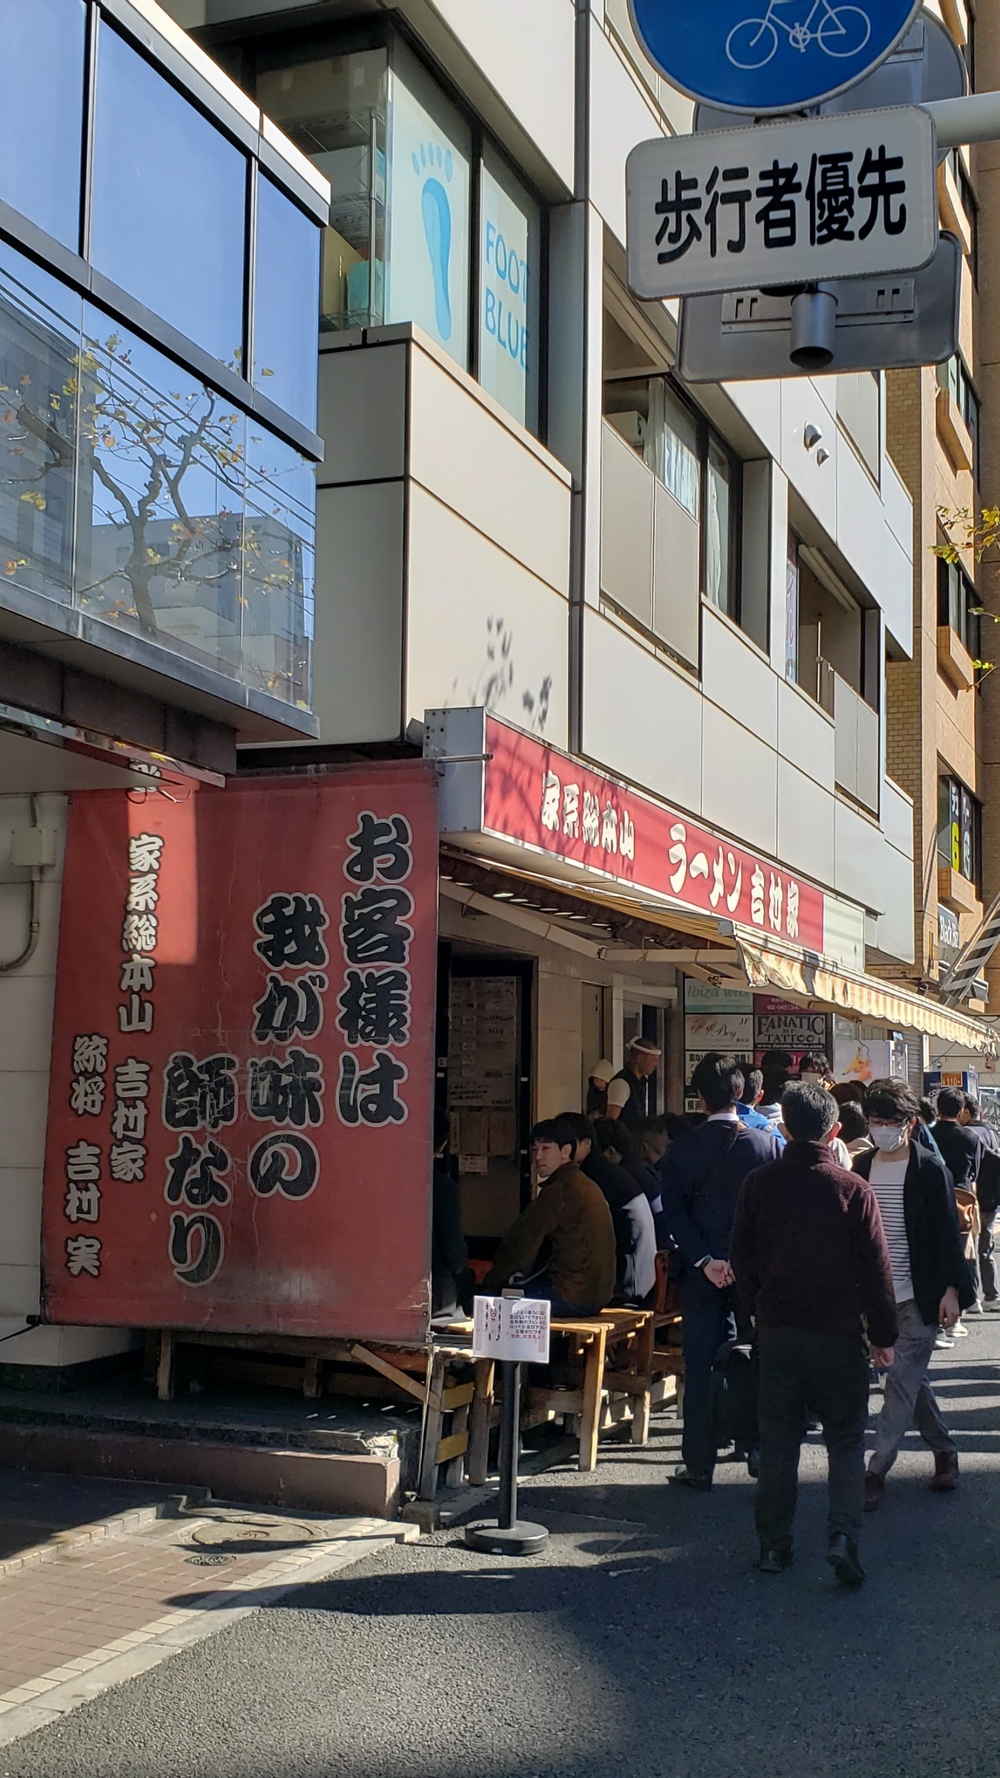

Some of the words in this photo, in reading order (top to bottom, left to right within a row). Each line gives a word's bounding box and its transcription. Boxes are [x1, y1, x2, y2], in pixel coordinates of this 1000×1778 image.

[655, 145, 906, 264] 歩行者優先
[485, 220, 529, 304] FOOT
[485, 288, 528, 370] BLUE
[541, 770, 635, 861] 家系総本山
[667, 824, 742, 912] ラーメン
[750, 864, 799, 938] 吉村家
[118, 834, 164, 1034] 家系総本山
[336, 811, 415, 1127] お客様は
[71, 1034, 108, 1115] 統将
[246, 892, 331, 1200] 我が味の
[756, 1015, 824, 1038] FANATIC
[764, 1034, 815, 1043] TATTOO
[109, 1058, 150, 1182] 吉村家
[163, 1051, 239, 1287] 師なり
[65, 1140, 102, 1222] 吉村
[65, 1235, 102, 1277] 実
